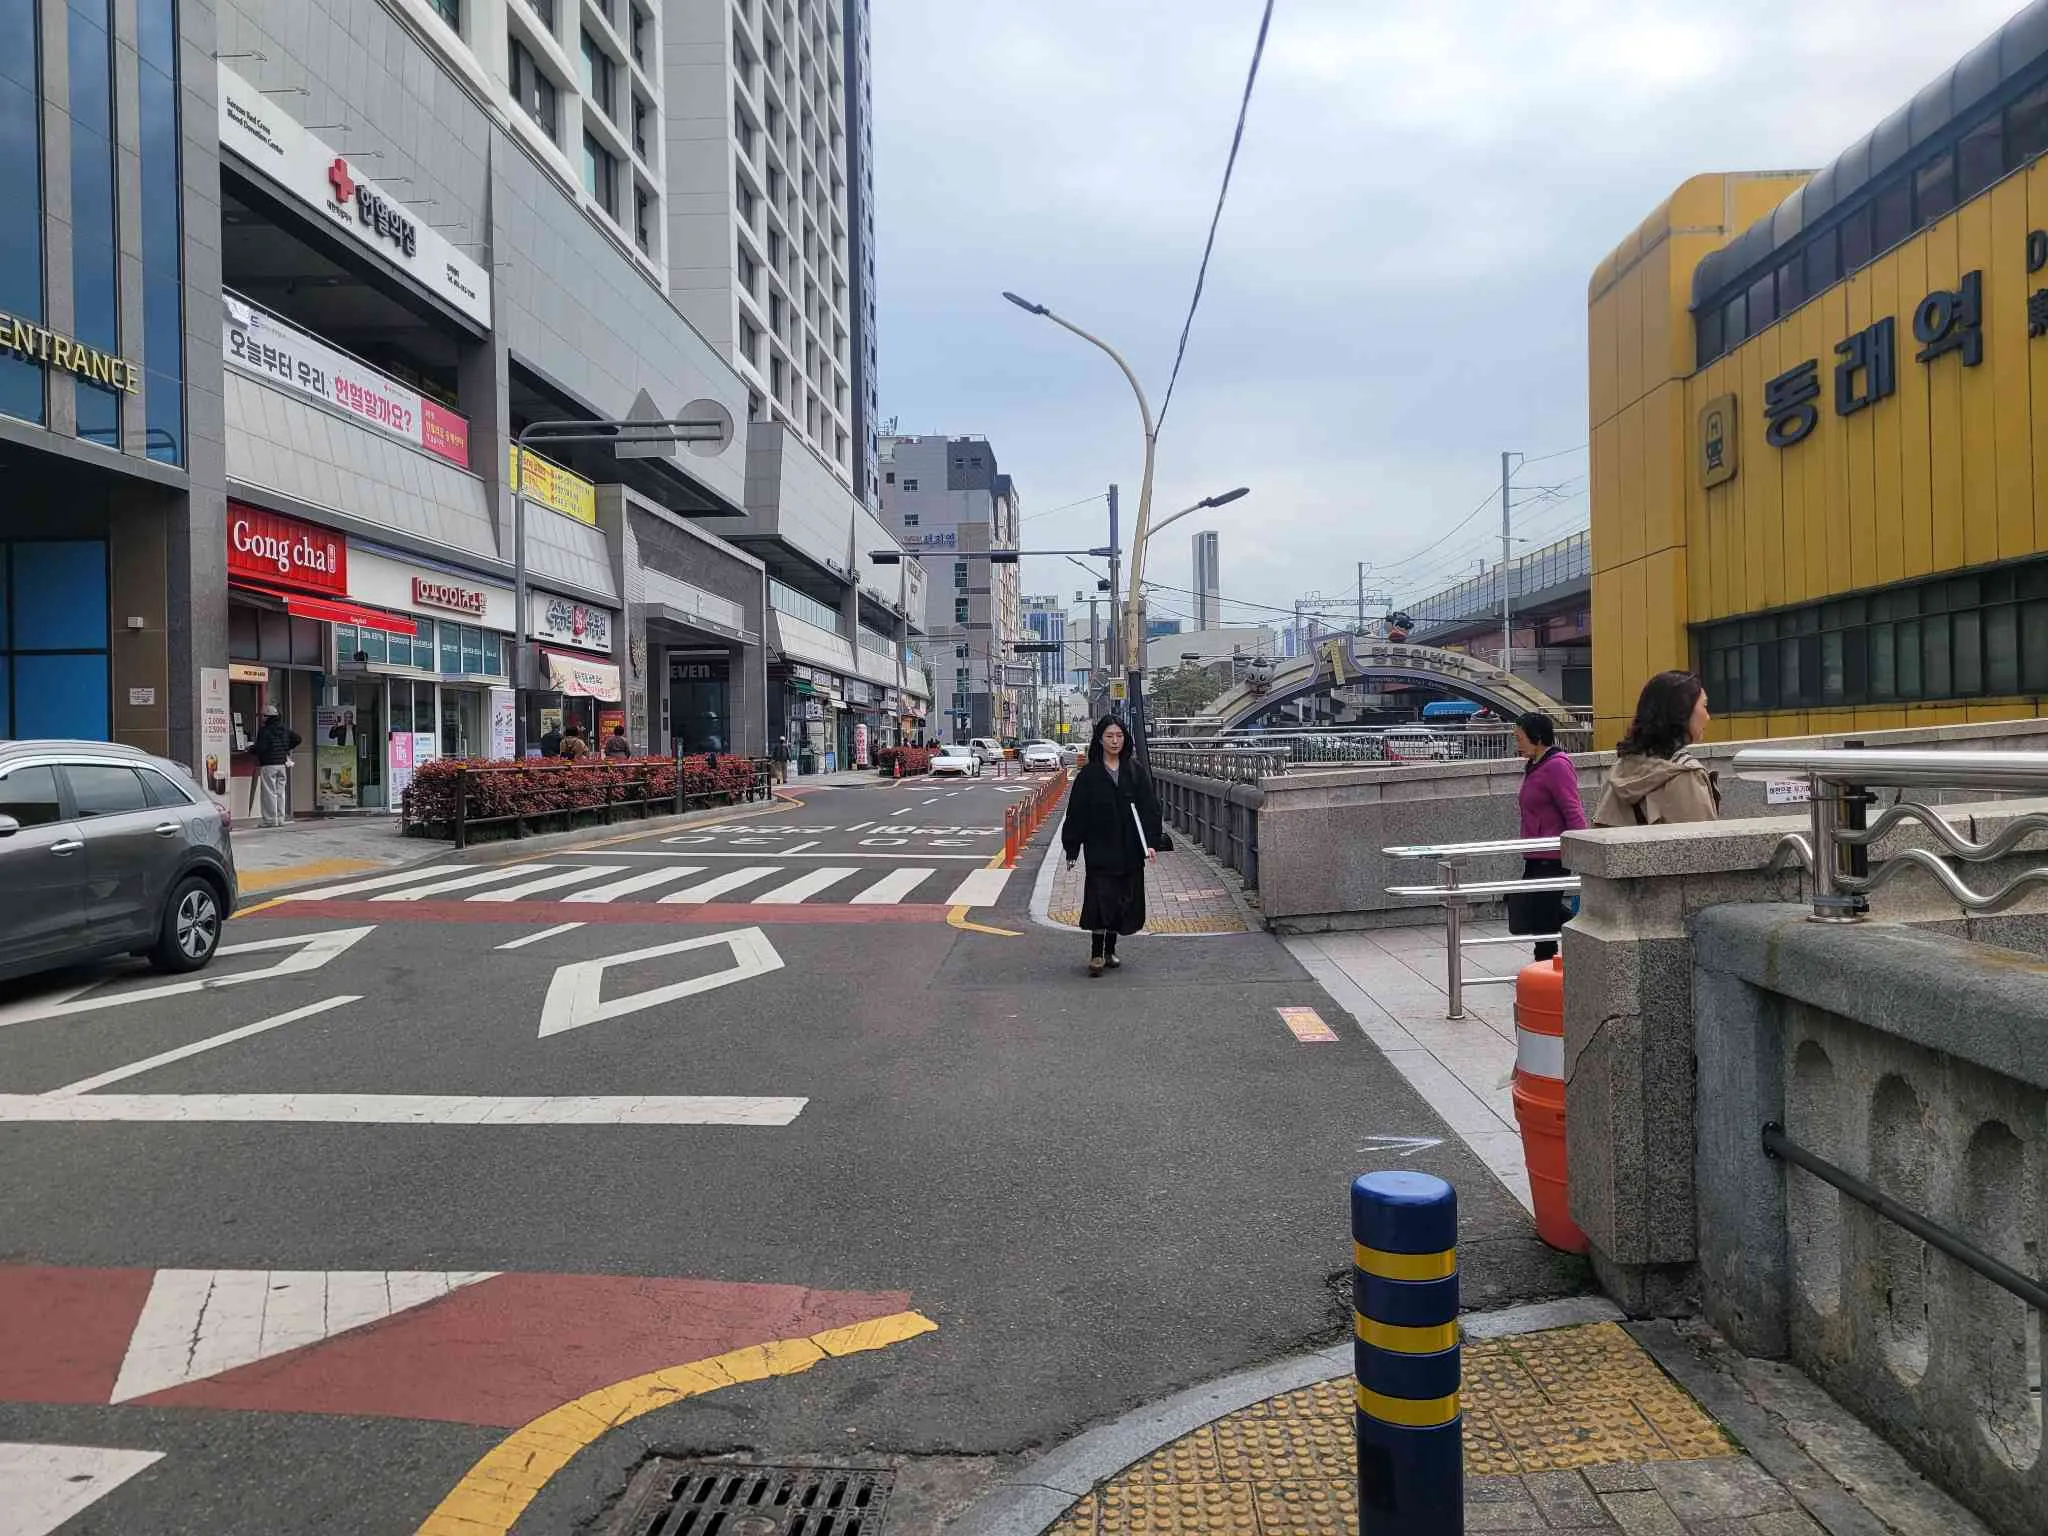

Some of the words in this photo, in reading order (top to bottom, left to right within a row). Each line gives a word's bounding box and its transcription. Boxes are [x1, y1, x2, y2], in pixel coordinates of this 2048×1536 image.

[230, 329, 293, 381] 오늘부터
[297, 361, 330, 398] 우리,
[334, 375, 413, 433] 헌혈할까요?
[1763, 269, 1983, 448] 동래역
[233, 520, 290, 573] Gong
[293, 536, 327, 572] cha
